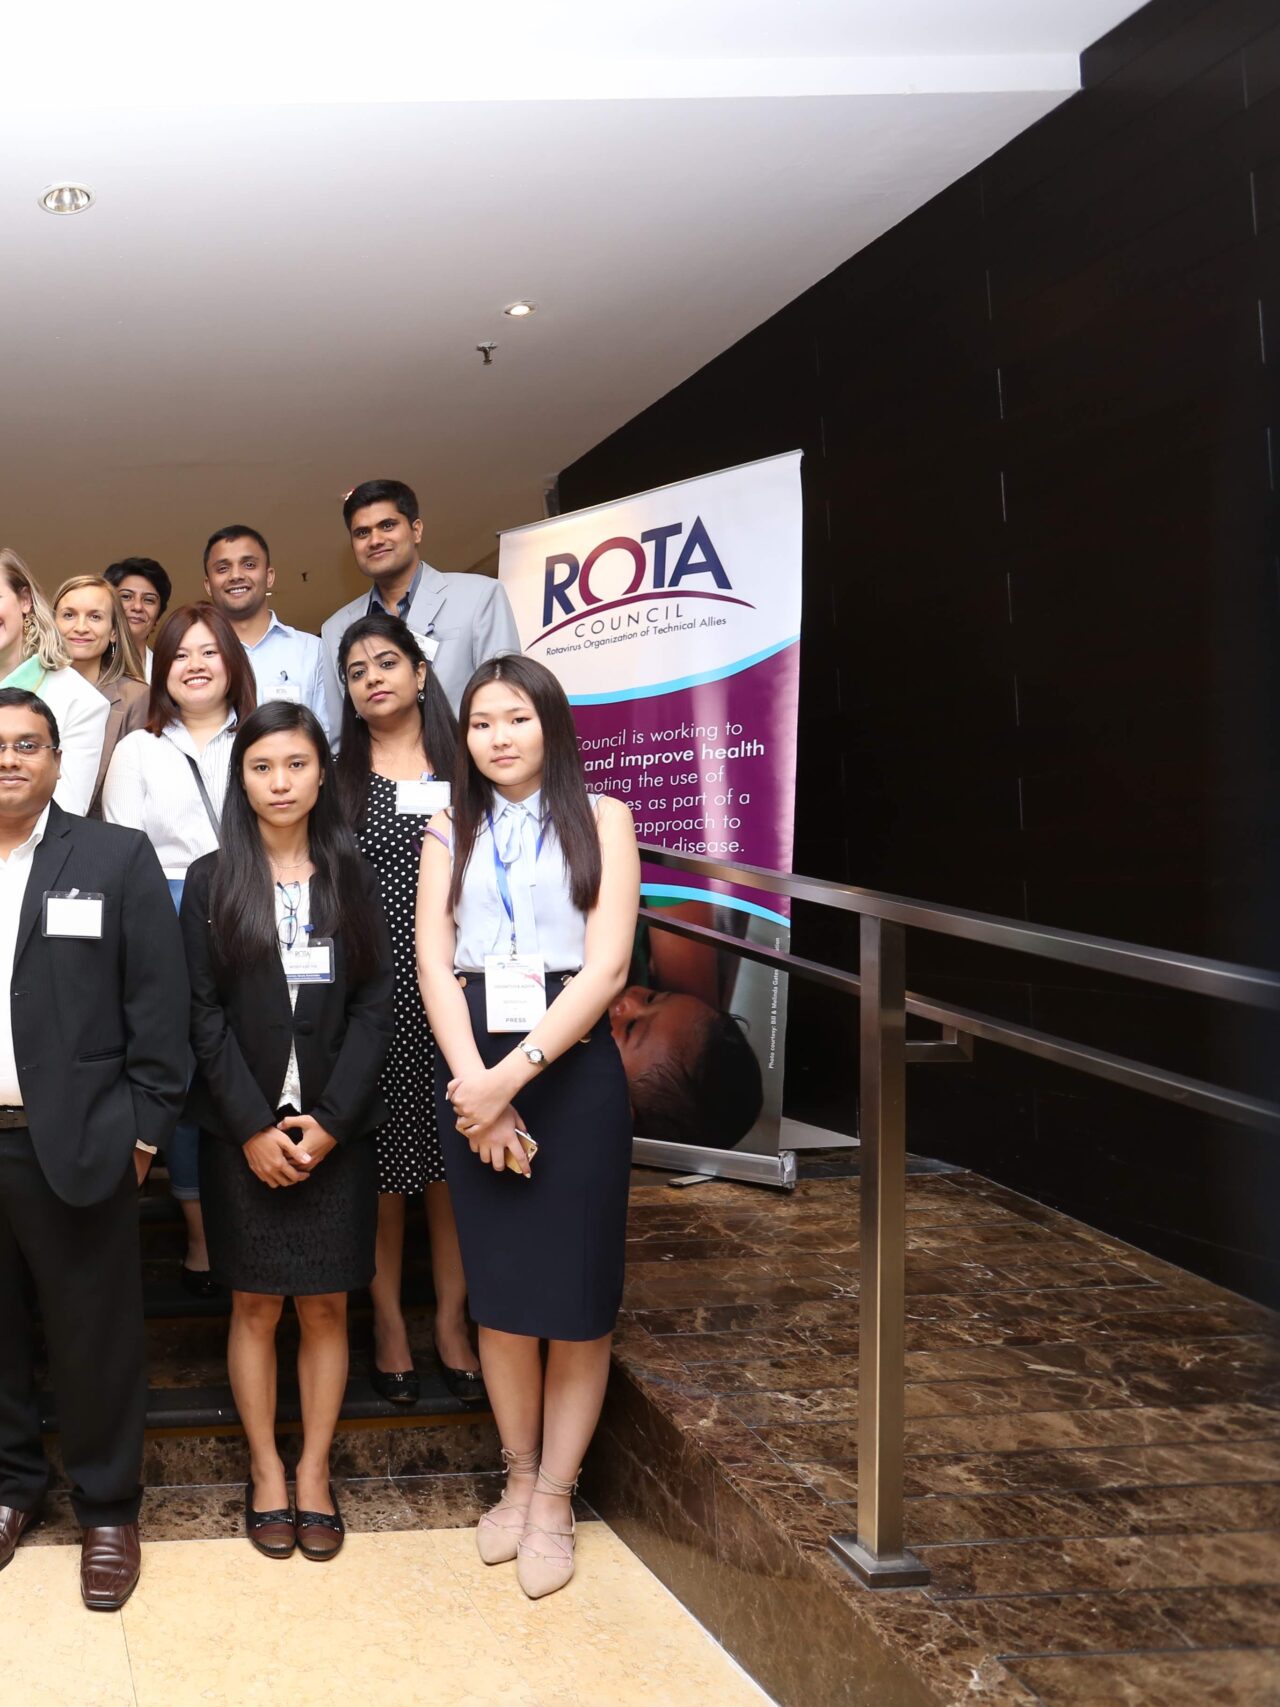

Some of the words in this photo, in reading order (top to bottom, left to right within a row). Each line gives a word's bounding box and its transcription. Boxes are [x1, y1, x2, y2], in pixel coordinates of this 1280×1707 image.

[543, 515, 733, 628] ROTA
[575, 603, 683, 638] COUNCIL
[546, 644, 582, 656] Rotavirus
[583, 631, 638, 649] Organization
[640, 626, 650, 637] of
[653, 618, 696, 635] Technical
[699, 616, 727, 628] Allies
[632, 729, 644, 745] is
[650, 721, 718, 742] working
[725, 721, 743, 736] to
[584, 752, 615, 772] and
[620, 749, 694, 770] improve
[701, 739, 765, 760] health
[584, 776, 632, 793] moting
[638, 771, 664, 788] the
[670, 772, 698, 786] use
[705, 765, 725, 783] of
[648, 798, 667, 810] as
[672, 791, 707, 812] part
[713, 788, 734, 807] of
[739, 793, 750, 805] a
[634, 812, 715, 837] approach
[723, 814, 741, 829] to
[672, 836, 745, 853] disease.
